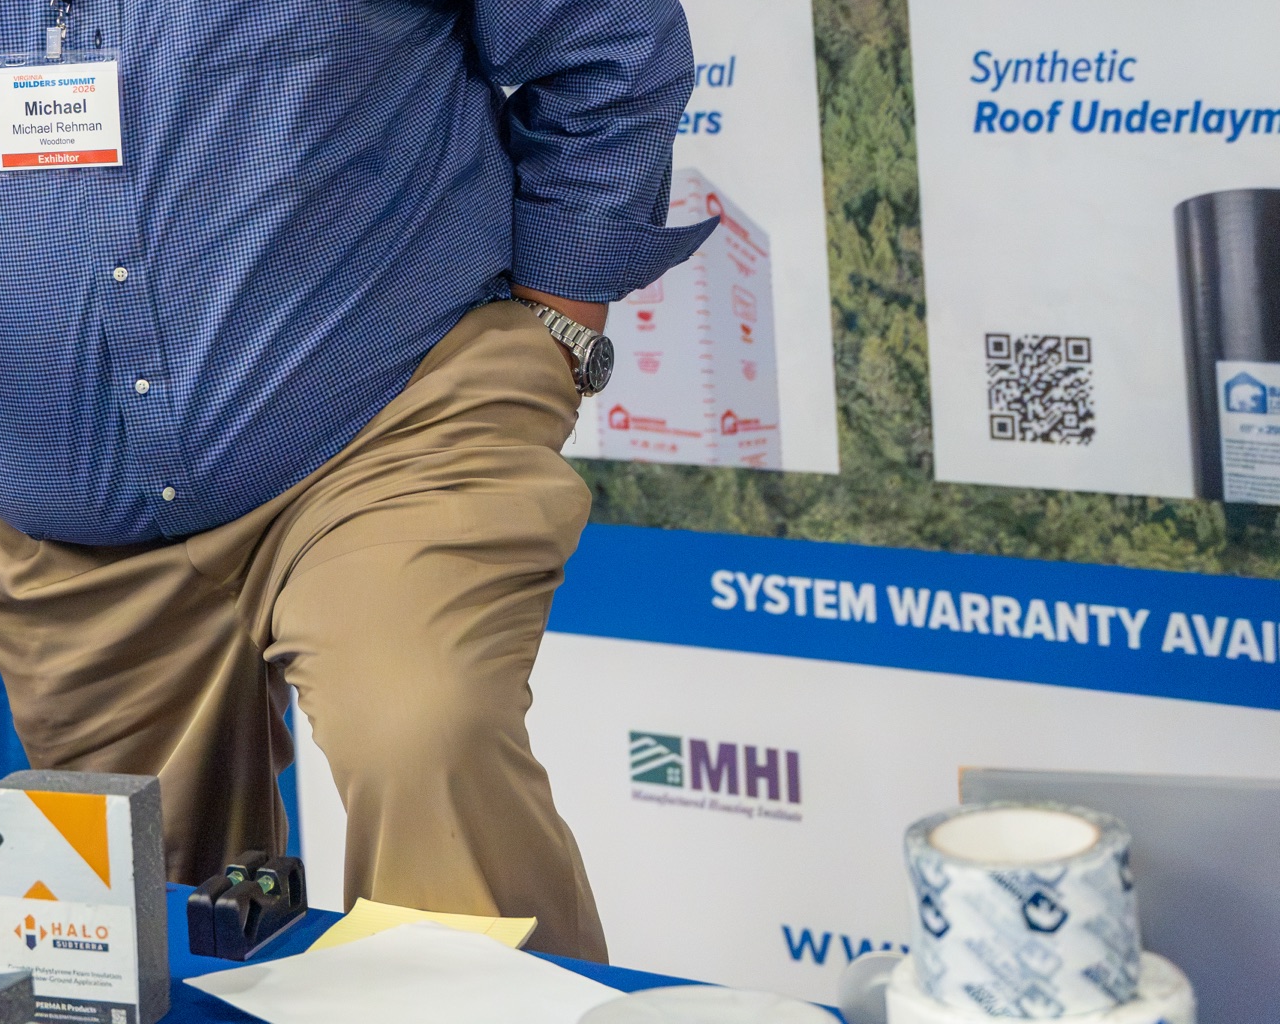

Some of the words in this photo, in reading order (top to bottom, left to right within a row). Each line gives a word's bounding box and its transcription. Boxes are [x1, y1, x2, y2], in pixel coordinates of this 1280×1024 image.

[970, 47, 1137, 91] Synthetic
[13, 79, 56, 89] BUILDERS
[58, 77, 96, 86] SUMMIT
[72, 85, 96, 94] 2026
[24, 98, 87, 116] Michael
[12, 123, 53, 135] Michael
[56, 121, 102, 133] Rehman
[973, 99, 1062, 134] Roof
[1070, 98, 1280, 143] Underlaym
[39, 138, 75, 146] Woodtone
[37, 153, 80, 164] Exhibitor
[710, 568, 878, 625] SYSTEM
[886, 585, 1150, 651] WARRANTY
[689, 738, 801, 805] MHI
[51, 922, 109, 940] HALO
[56, 941, 104, 951] SUBTERRA
